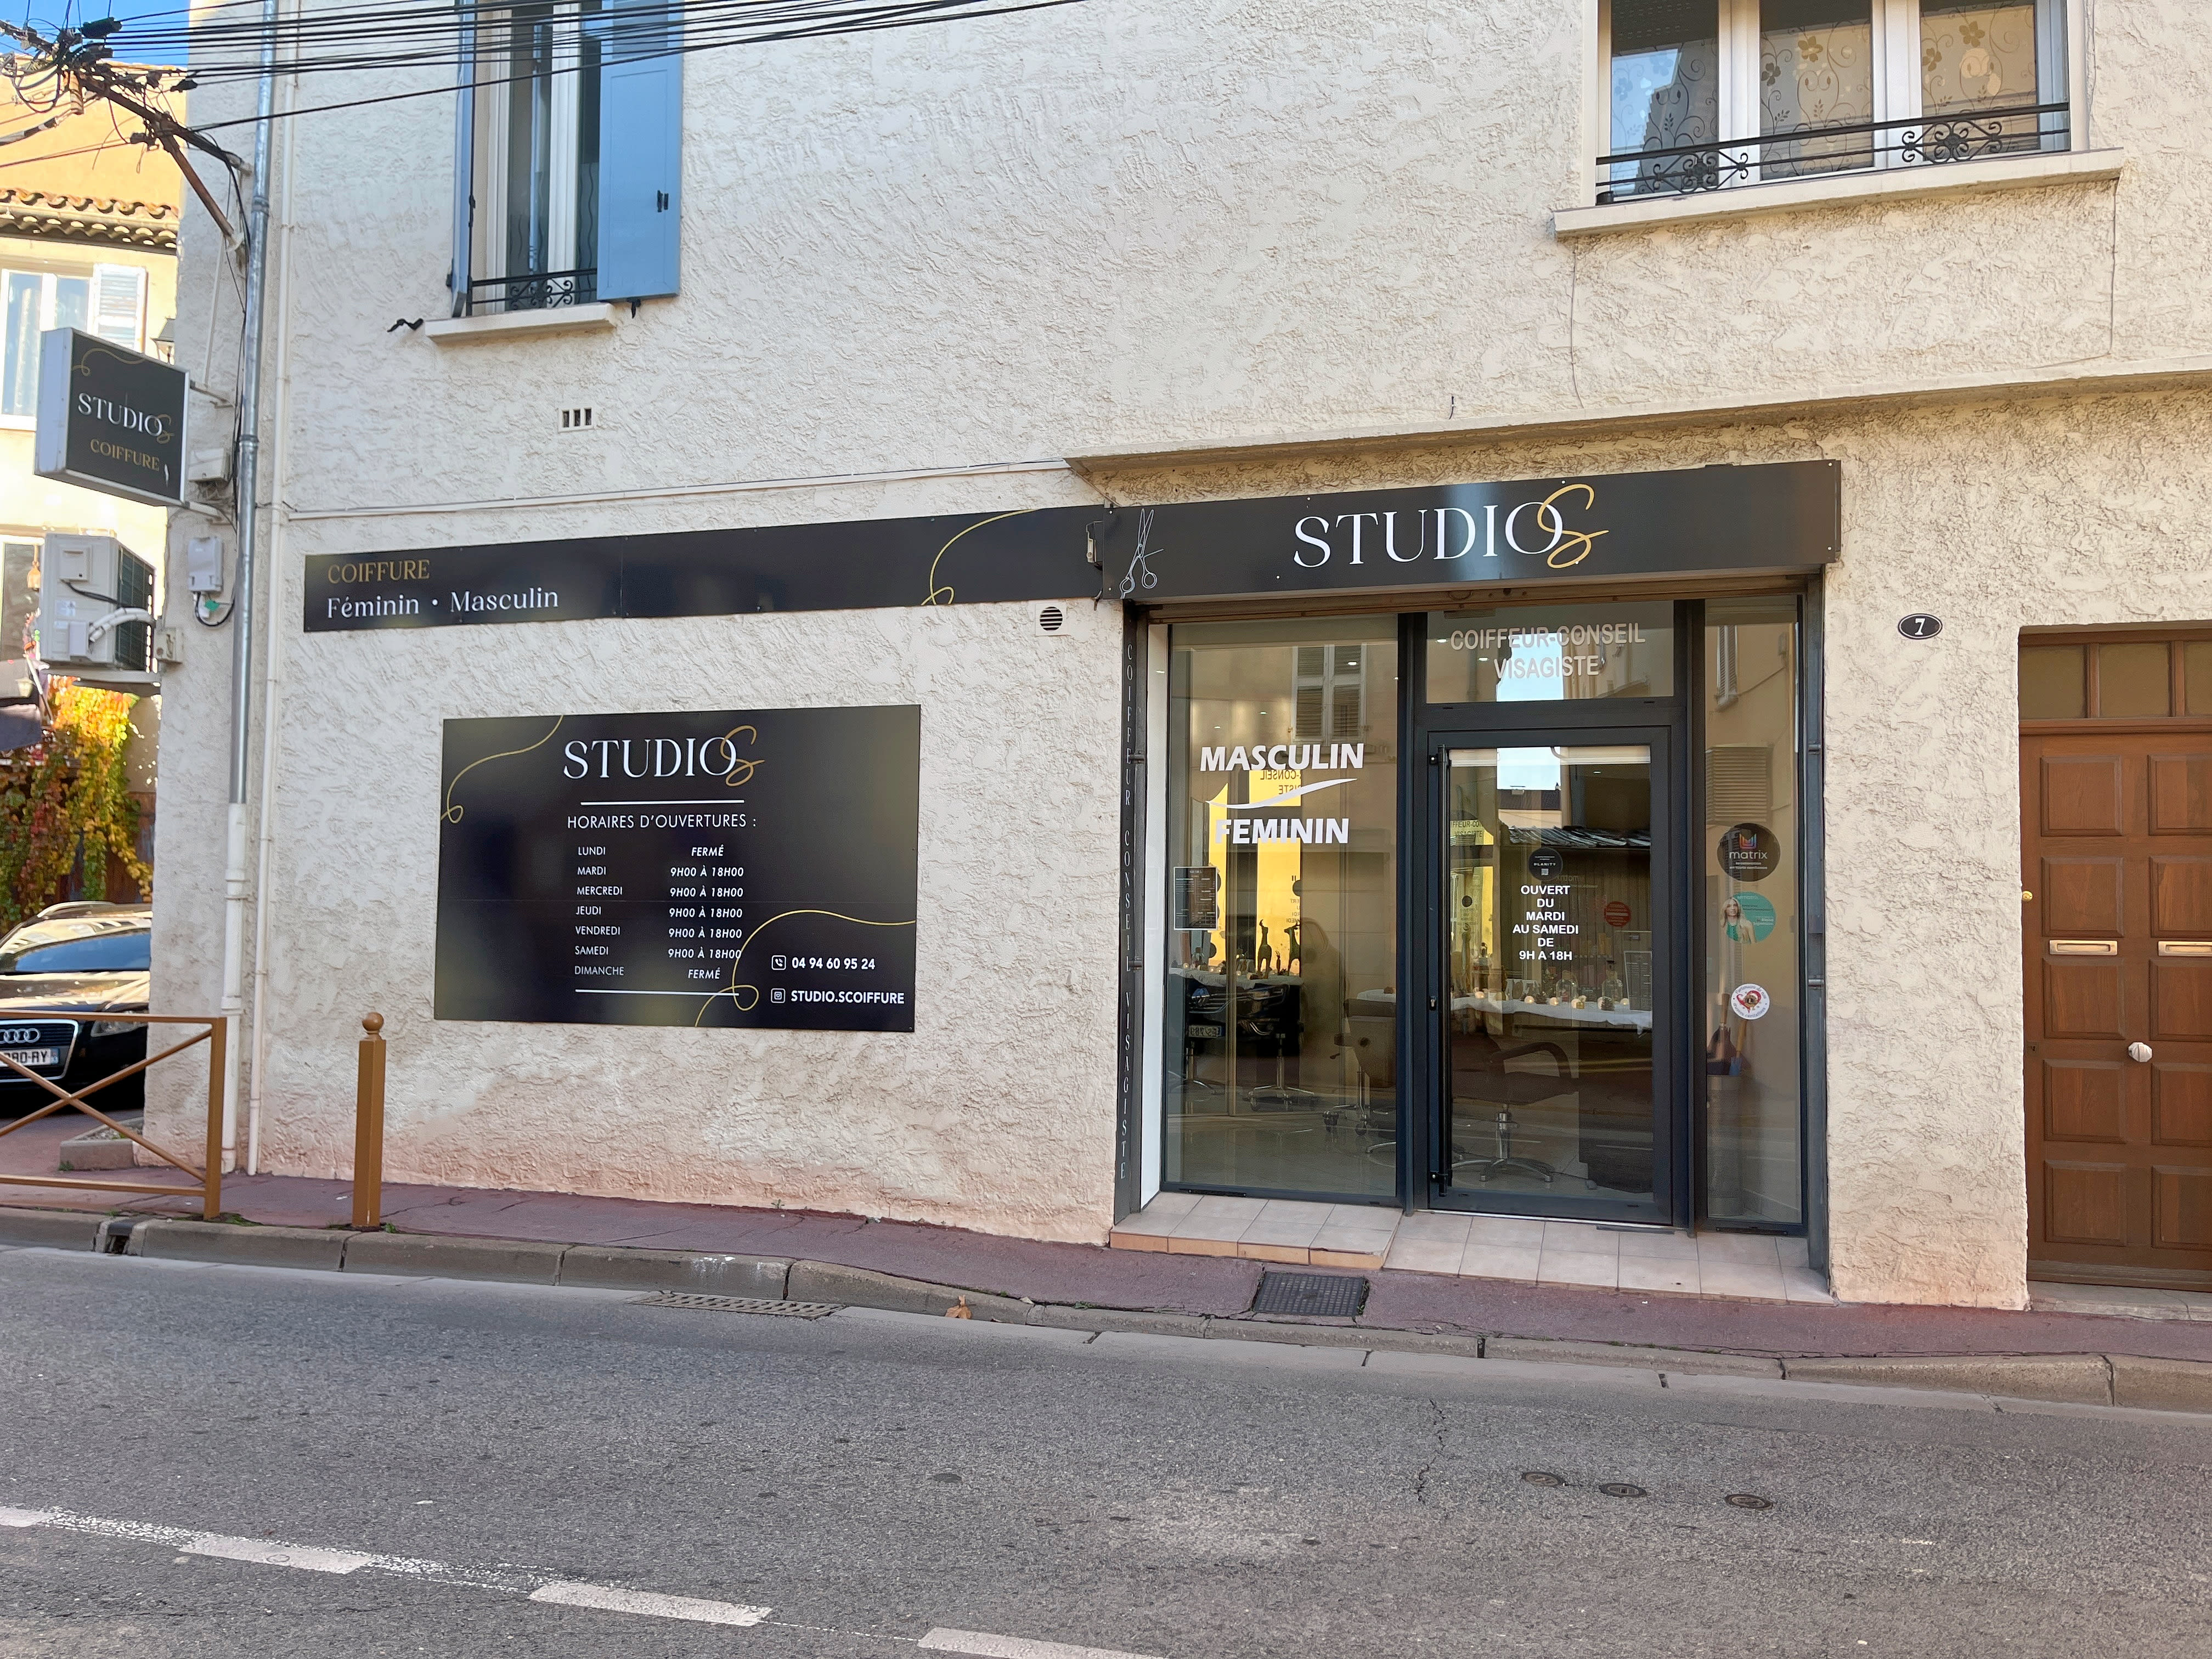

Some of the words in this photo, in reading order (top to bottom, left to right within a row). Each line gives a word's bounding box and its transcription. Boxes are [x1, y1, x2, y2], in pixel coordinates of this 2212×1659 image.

[90, 439, 160, 471] COIFFURE
[328, 559, 430, 584] COIFFURE
[328, 594, 419, 618] Féminin
[450, 588, 558, 613] Masculin
[1915, 618, 1926, 635] 7
[1449, 623, 1646, 651] COIFFEUR-CONSEIL
[1494, 655, 1599, 679] VISAGISTE
[1200, 743, 1364, 771] MASCULIN
[568, 815, 634, 829] HORAIRES
[640, 814, 746, 828] D'OUVERTURES
[1215, 818, 1350, 844] FEMININ
[578, 846, 606, 856] LUNDI
[691, 844, 724, 856] FERMÉ
[1729, 850, 1768, 860] matrix
[577, 866, 606, 876] MARDI
[670, 867, 697, 877] 9H00
[699, 865, 707, 877] À
[712, 867, 744, 877] 18H00
[577, 886, 623, 895] MERCREDI
[670, 887, 696, 897] 9H00
[699, 885, 707, 897] À
[712, 887, 743, 897] 18H00
[1520, 885, 1571, 895] OUVERT
[1537, 898, 1554, 908] DU
[575, 906, 601, 915] JEUDI
[669, 907, 695, 918] 9H00
[698, 906, 706, 918] À
[710, 908, 743, 918] 18H00
[1526, 911, 1565, 921] MARDI
[575, 926, 620, 935] VENDREDI
[668, 928, 695, 938] 9H00
[698, 926, 706, 938] À
[710, 928, 742, 939] 18H00
[1513, 924, 1530, 934] AU
[1532, 924, 1578, 934] SAMEDI
[1537, 938, 1554, 947] DE
[575, 945, 608, 955] SAMEDI
[668, 948, 695, 958] 9H00
[697, 946, 705, 958] À
[709, 949, 742, 959] 18H00
[1519, 950, 1535, 960] 9H
[1538, 951, 1547, 960] A
[1549, 951, 1572, 961] 18H
[792, 957, 806, 969] 04
[809, 957, 823, 969] 94
[826, 957, 840, 969] 60
[843, 957, 857, 969] 95
[861, 958, 876, 970] 24
[574, 966, 624, 976] DIMANCHE
[688, 967, 720, 979] FERMÉ
[791, 990, 905, 1005] STUDIO.SCOIFFURE
[1121, 991, 1131, 1179] VISAGISTE
